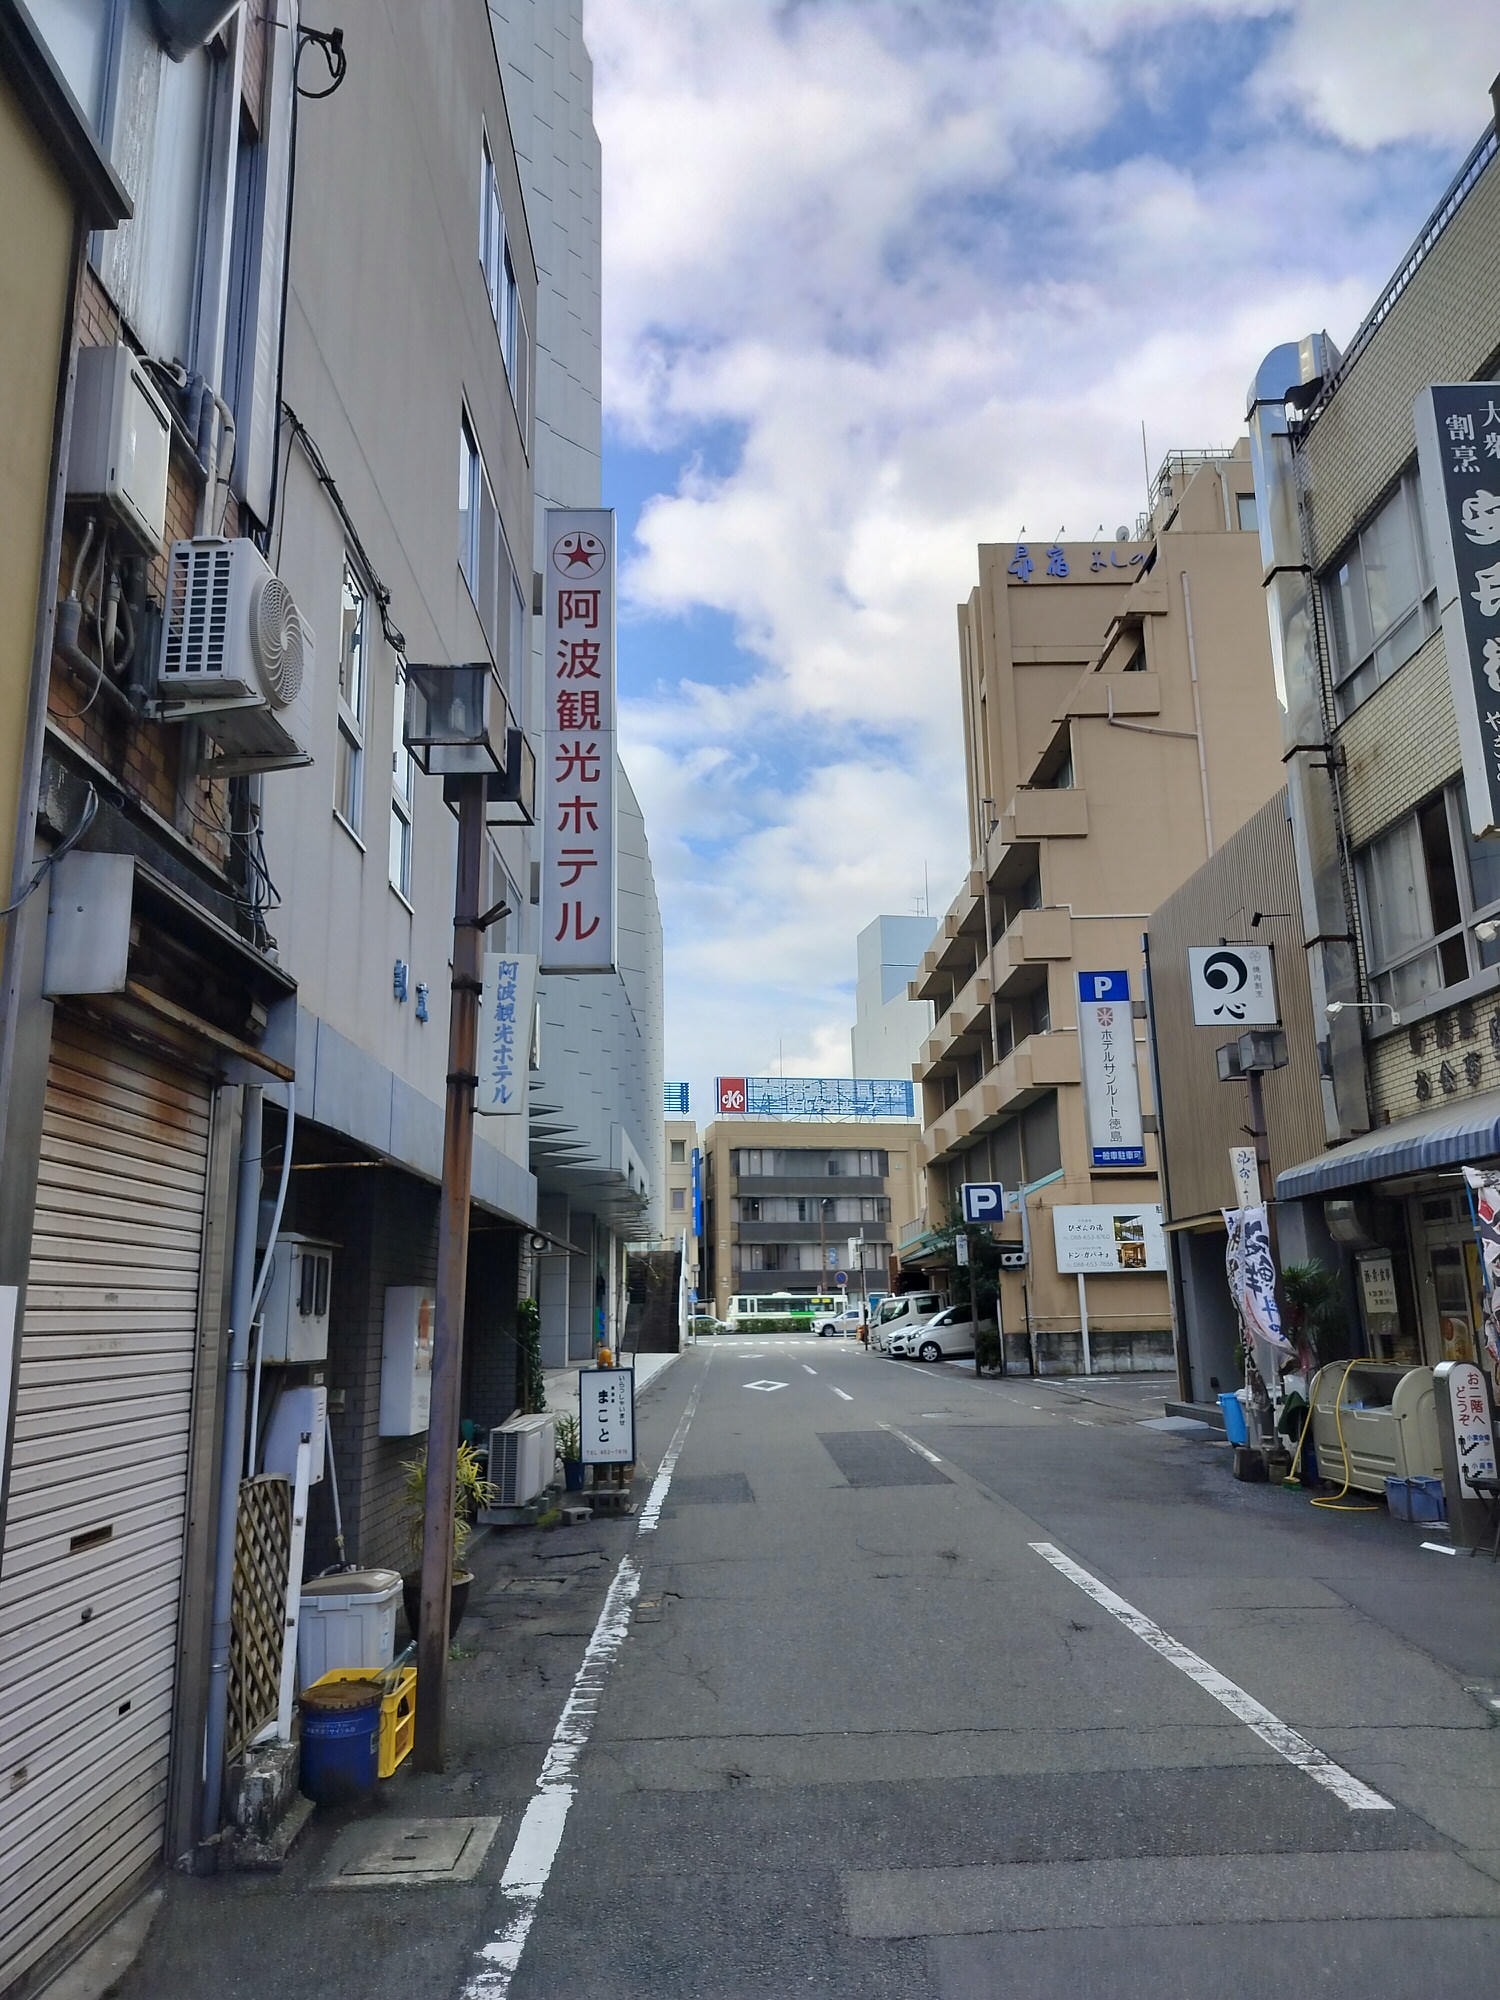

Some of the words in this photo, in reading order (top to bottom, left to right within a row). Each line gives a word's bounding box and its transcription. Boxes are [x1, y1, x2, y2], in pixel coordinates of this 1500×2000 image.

[1445, 414, 1481, 474] 割烹
[555, 590, 602, 942] 阿波観光ホテル
[1094, 976, 1112, 998] P
[492, 960, 519, 1104] 阿波観光ホテル
[1101, 1029, 1123, 1142] ホテルサンルート徳島
[969, 1188, 998, 1218] P
[598, 1389, 610, 1443] まこと
[1456, 1386, 1470, 1426] どうぞ
[1467, 1372, 1486, 1424] お二階へ
